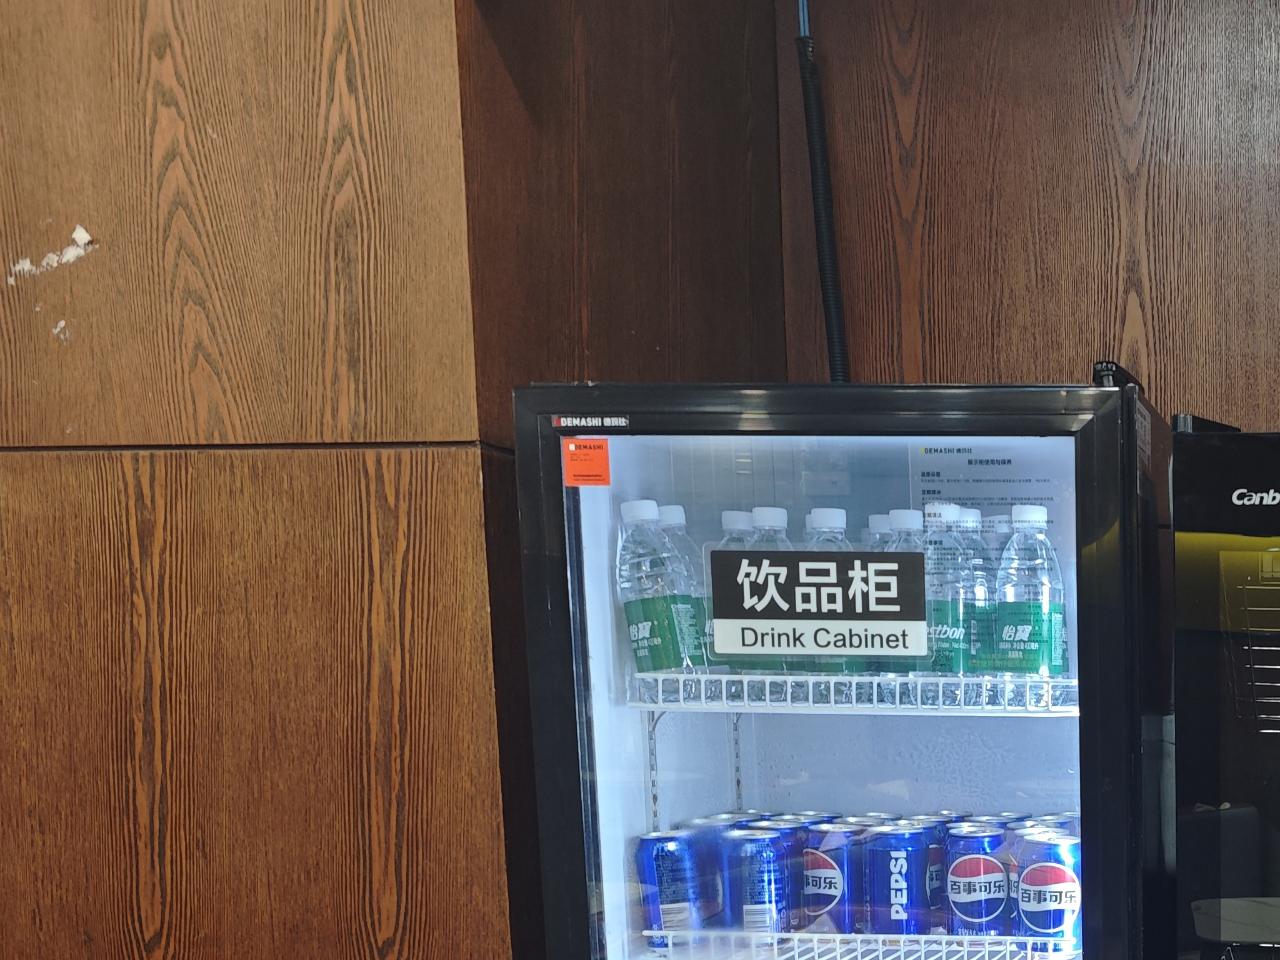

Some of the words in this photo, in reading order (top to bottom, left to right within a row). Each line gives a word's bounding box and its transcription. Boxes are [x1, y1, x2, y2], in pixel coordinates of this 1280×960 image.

[560, 416, 602, 427] DEMASHI
[736, 558, 901, 613] 饮品柜
[740, 627, 807, 649] Drink
[813, 627, 909, 650] Cabinet
[889, 850, 908, 920] PEPSI
[950, 879, 1006, 895] 百事可乐
[1020, 888, 1077, 904] 百事可乐
